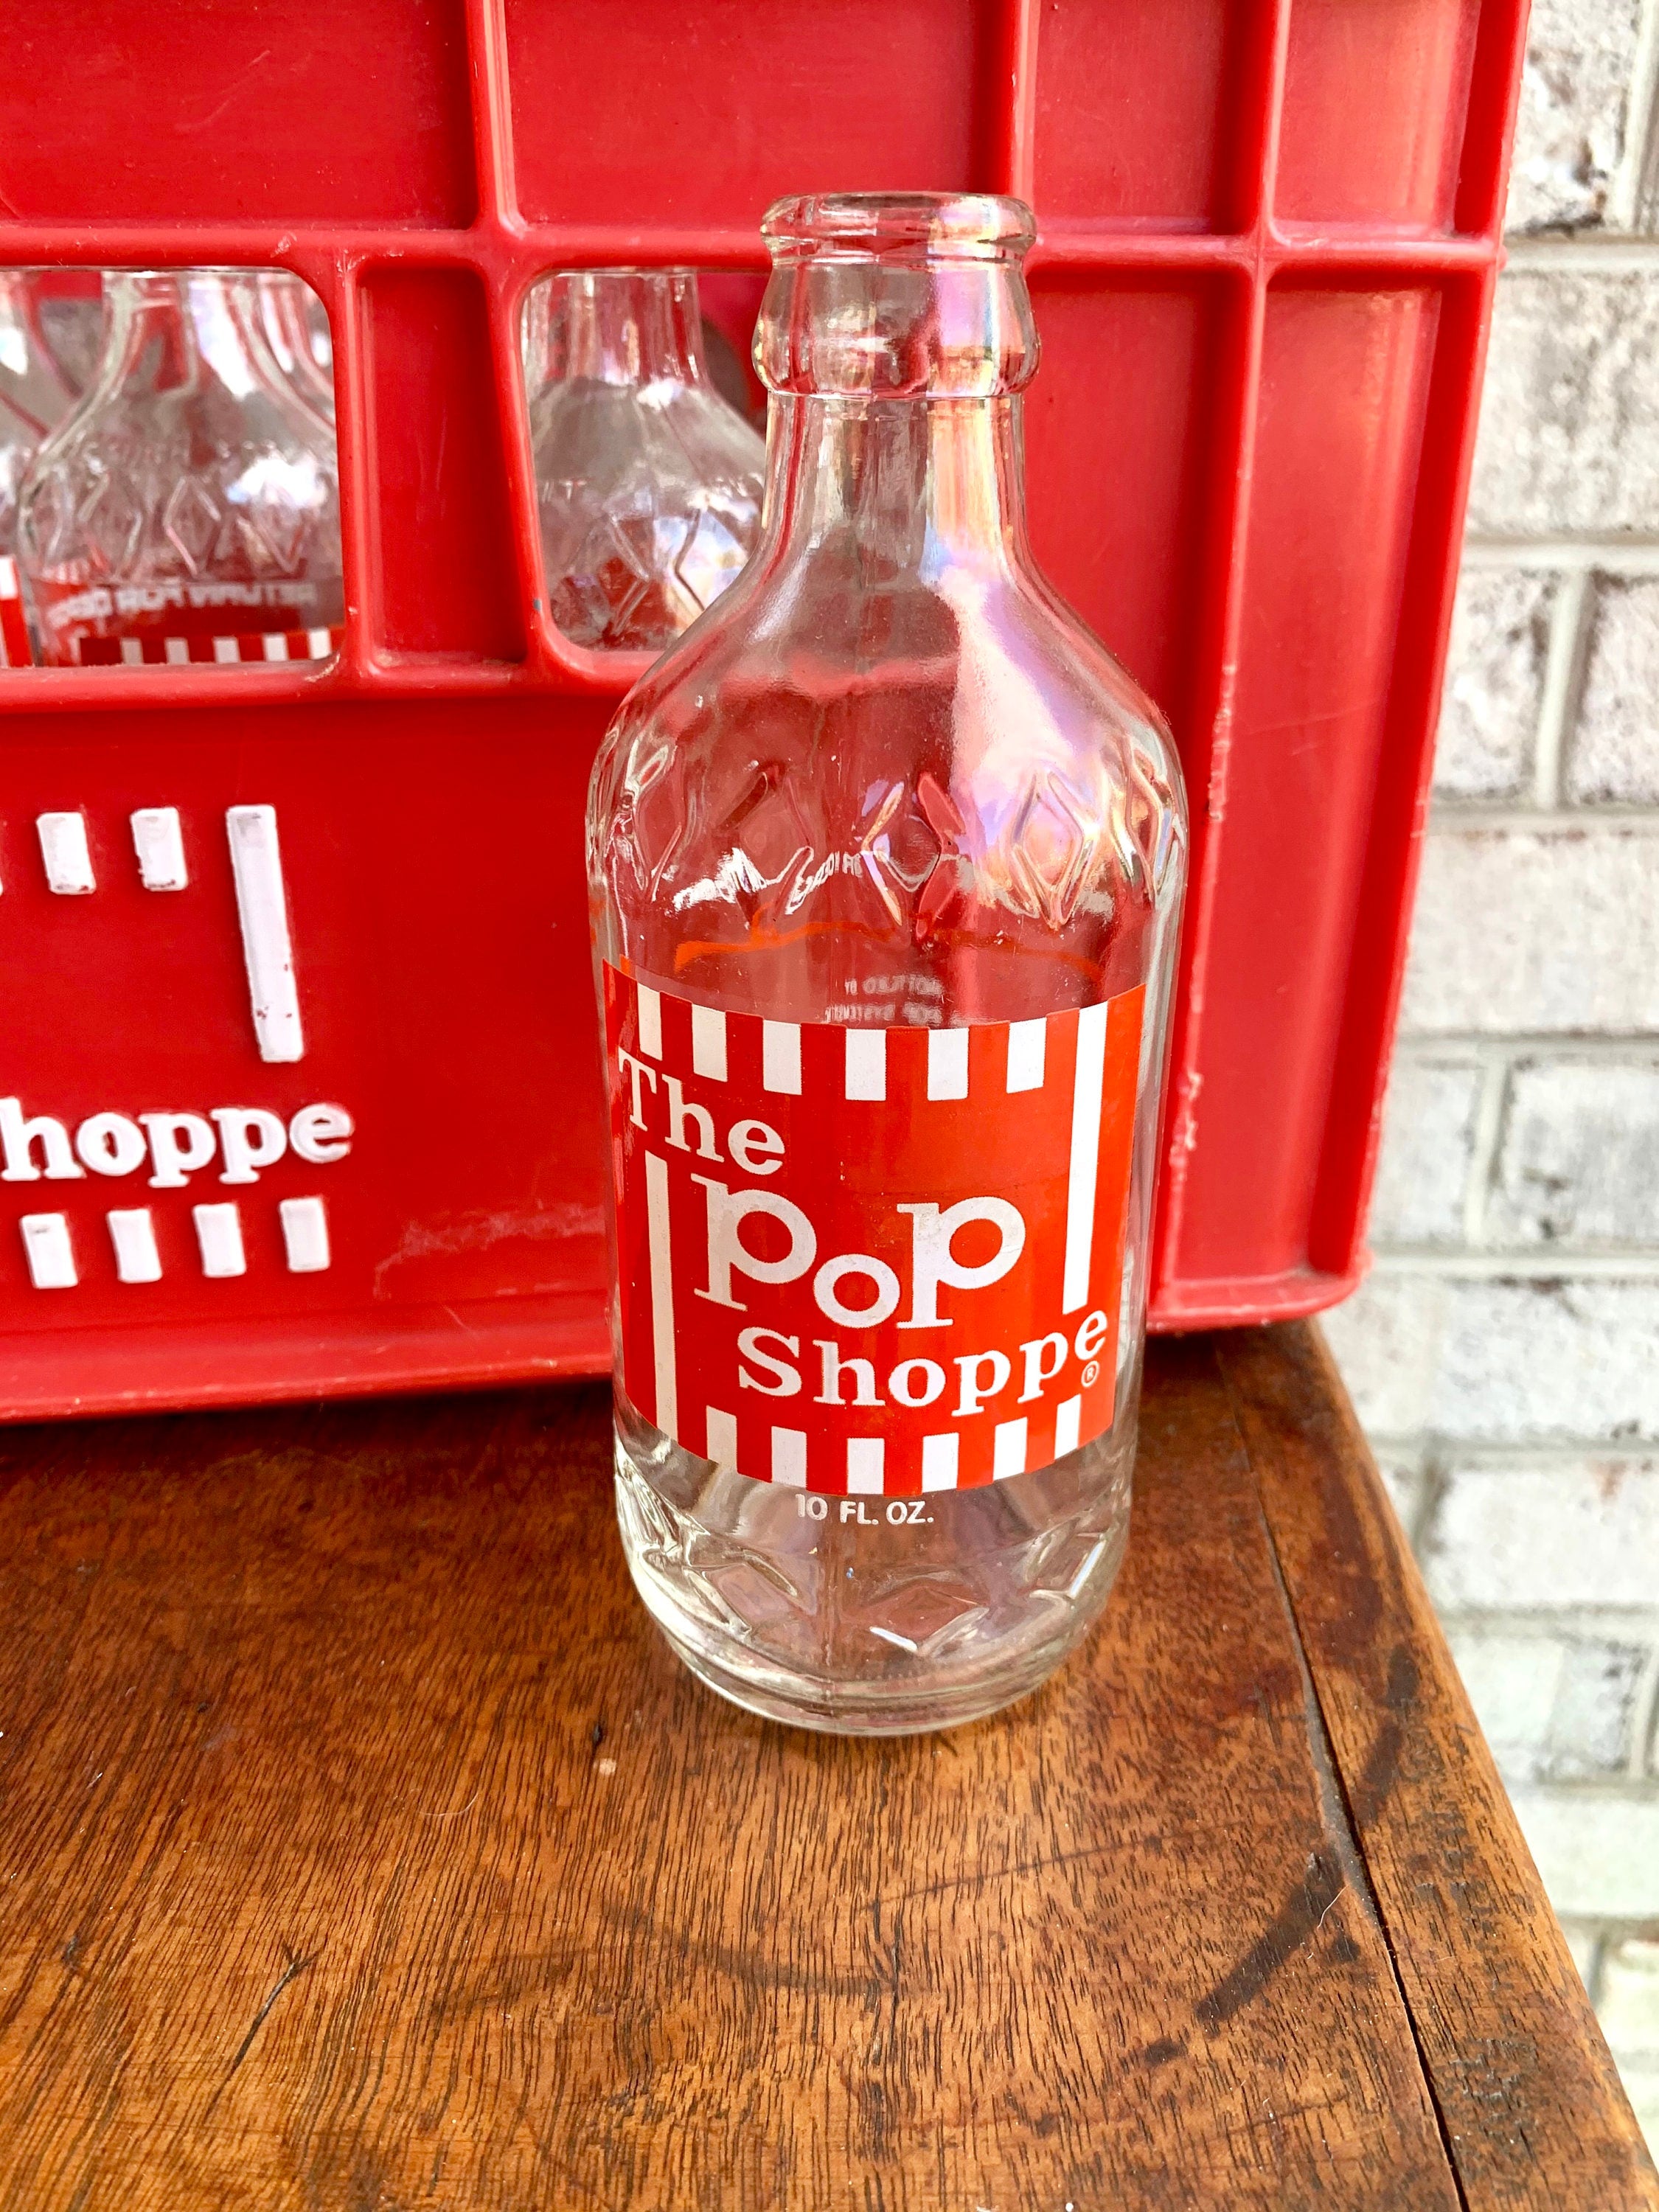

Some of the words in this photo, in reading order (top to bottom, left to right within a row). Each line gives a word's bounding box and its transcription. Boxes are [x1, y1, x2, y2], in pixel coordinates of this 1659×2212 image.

[618, 1048, 785, 1175] The
[737, 1310, 1107, 1416] Shoppe
[796, 1494, 828, 1520] 10
[840, 1500, 879, 1525] FL.
[886, 1501, 934, 1525] OZ.
